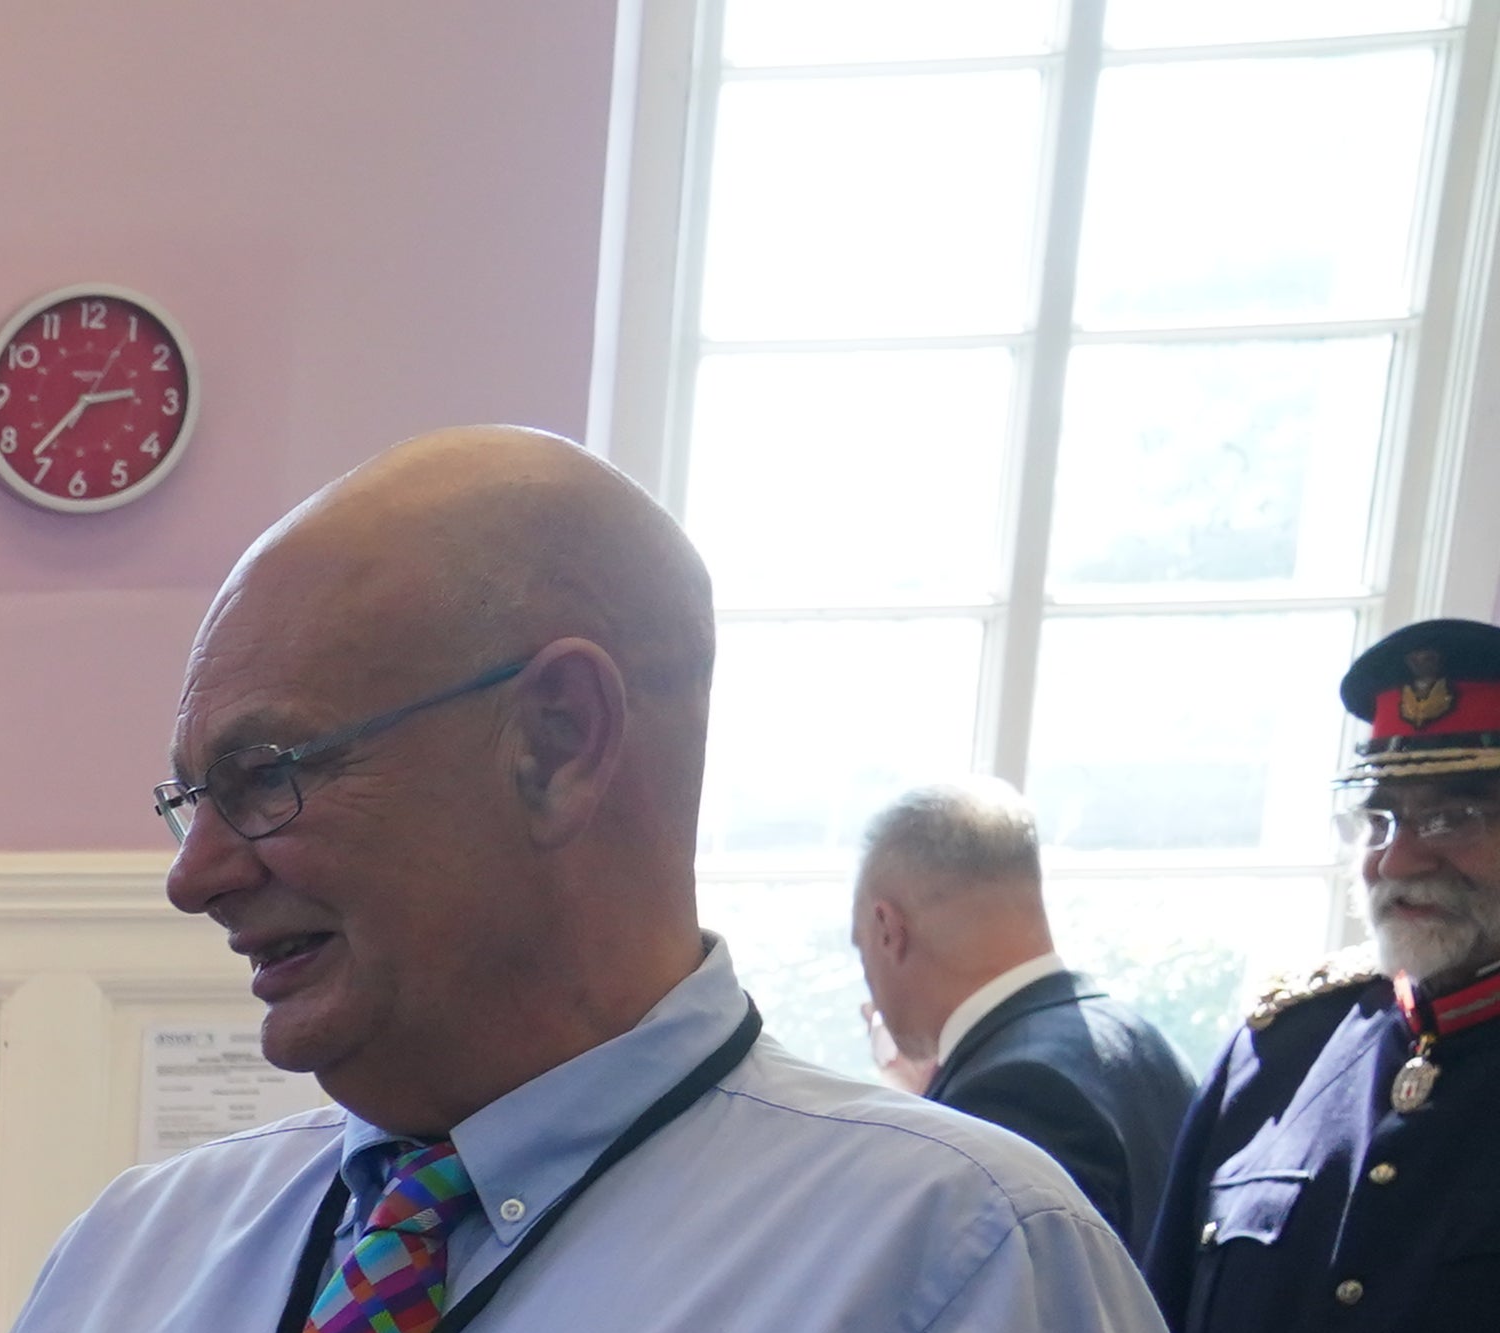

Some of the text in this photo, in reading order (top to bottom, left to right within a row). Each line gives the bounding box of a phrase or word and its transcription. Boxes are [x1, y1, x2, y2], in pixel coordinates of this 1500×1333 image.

[42, 313, 61, 340] 11
[80, 302, 107, 329] 12
[128, 315, 138, 342] 1
[7, 343, 41, 370] 10
[151, 344, 170, 372] 2
[161, 387, 180, 416] 3
[0, 425, 18, 454] 8
[139, 432, 161, 459] 4
[33, 457, 53, 484] 7
[68, 469, 88, 497] 6
[111, 459, 128, 487] 5
